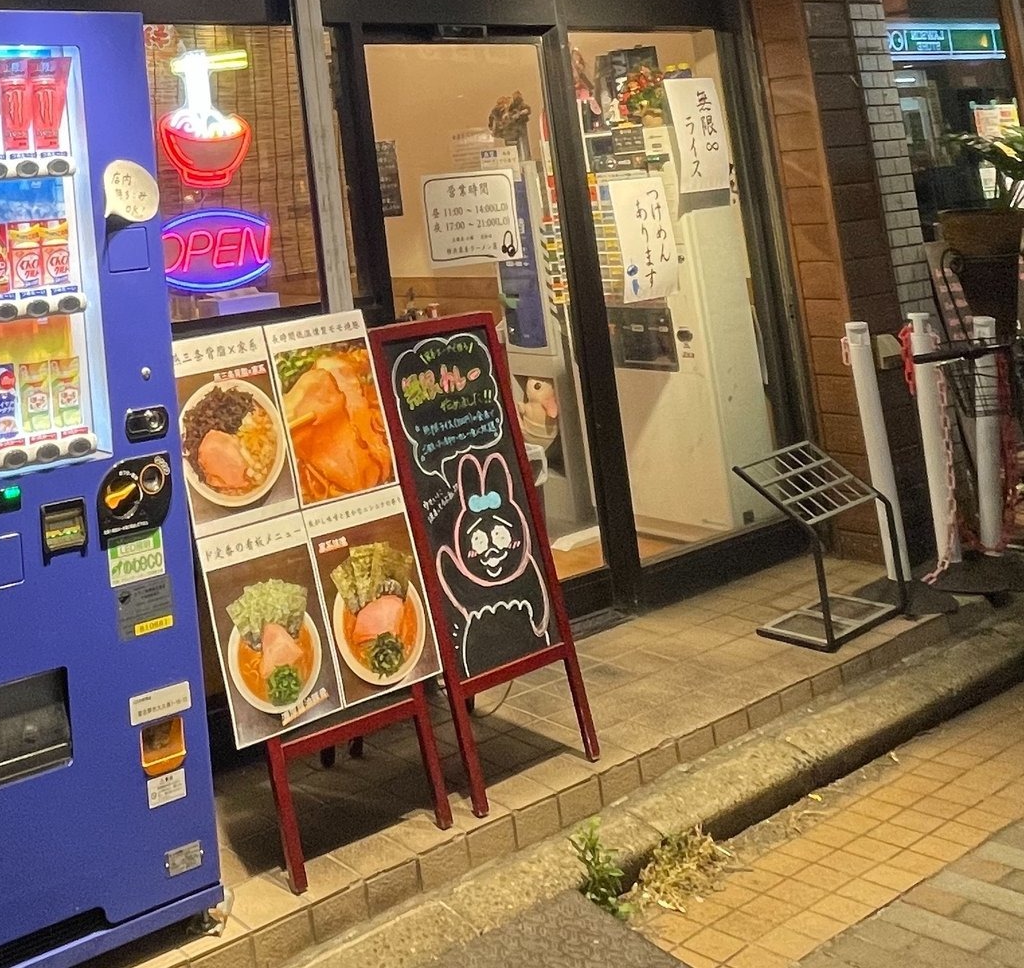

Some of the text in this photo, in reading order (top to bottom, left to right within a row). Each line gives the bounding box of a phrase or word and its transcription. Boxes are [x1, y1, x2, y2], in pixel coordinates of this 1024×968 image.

[685, 116, 703, 178] ライス
[443, 206, 464, 217] 11:00
[446, 182, 489, 198] 営業時間
[161, 224, 271, 273] OPEN
[446, 221, 466, 231] 17:00
[635, 200, 657, 288] あります
[646, 188, 671, 262] つけめん
